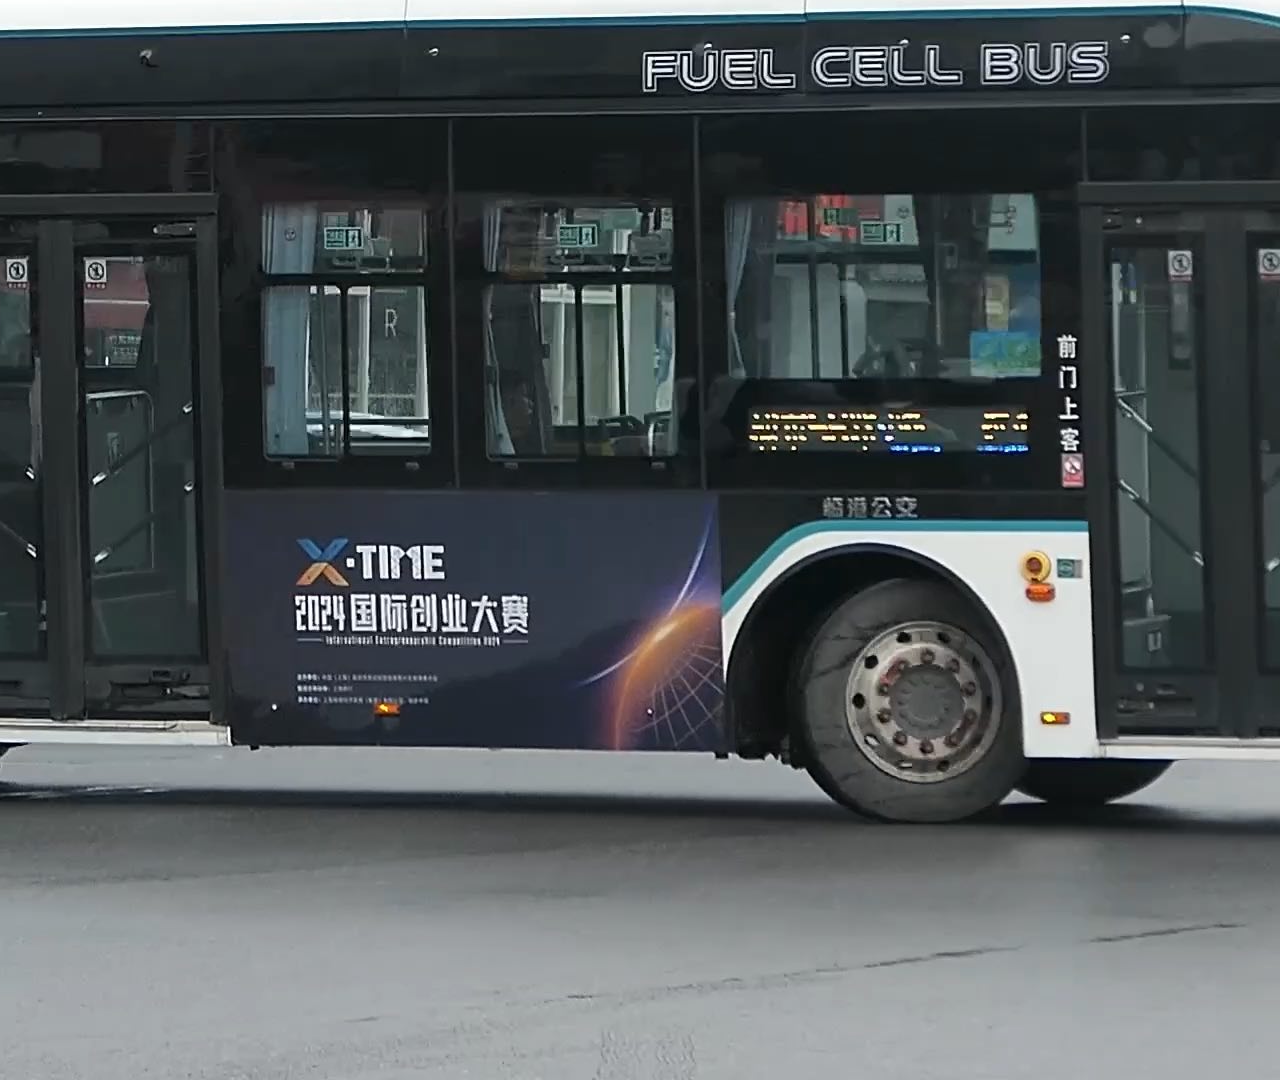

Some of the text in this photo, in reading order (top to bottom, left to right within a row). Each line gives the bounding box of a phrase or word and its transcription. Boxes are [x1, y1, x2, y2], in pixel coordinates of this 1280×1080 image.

[642, 41, 1109, 93] FUEL CELL BUS
[1057, 334, 1080, 452] 前门上客
[822, 496, 919, 519] 临港公交
[294, 593, 530, 635] 2024国际创业大赛
